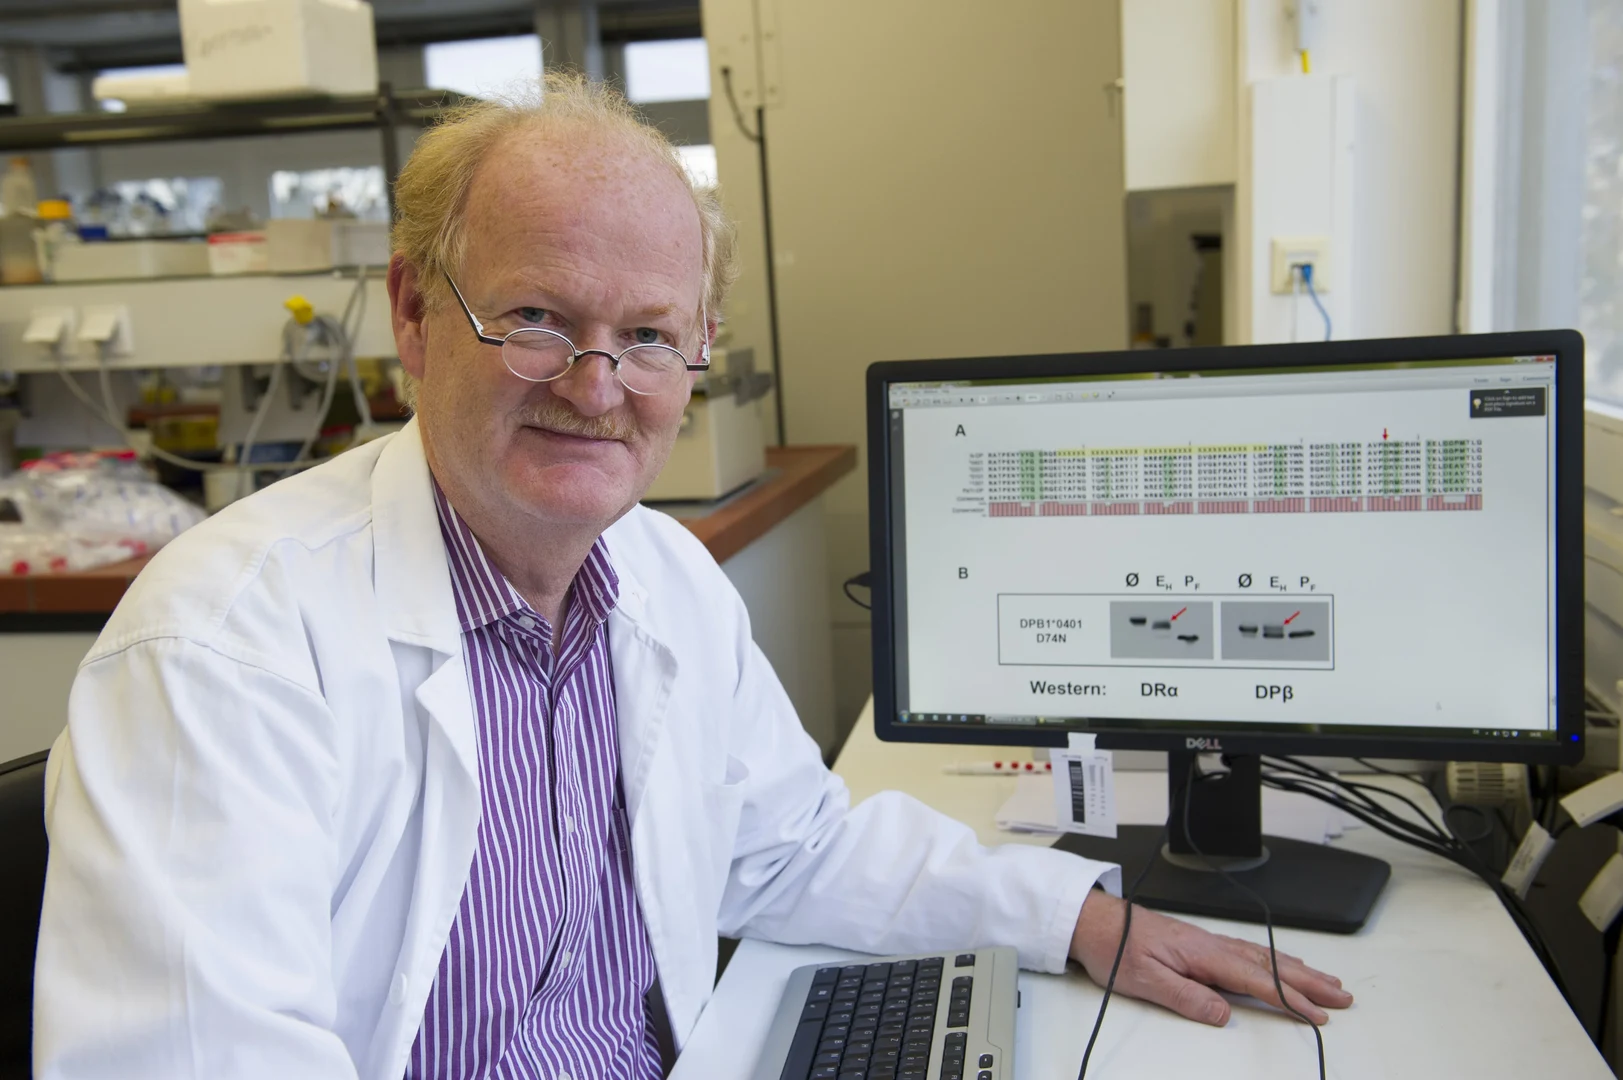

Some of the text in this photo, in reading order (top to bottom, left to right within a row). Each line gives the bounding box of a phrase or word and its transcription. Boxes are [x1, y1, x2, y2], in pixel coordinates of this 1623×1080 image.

[956, 424, 966, 436] A
[958, 567, 968, 579] B
[1036, 634, 1066, 643] D74N
[1030, 681, 1107, 695] Western:
[1186, 737, 1222, 750] DELL
